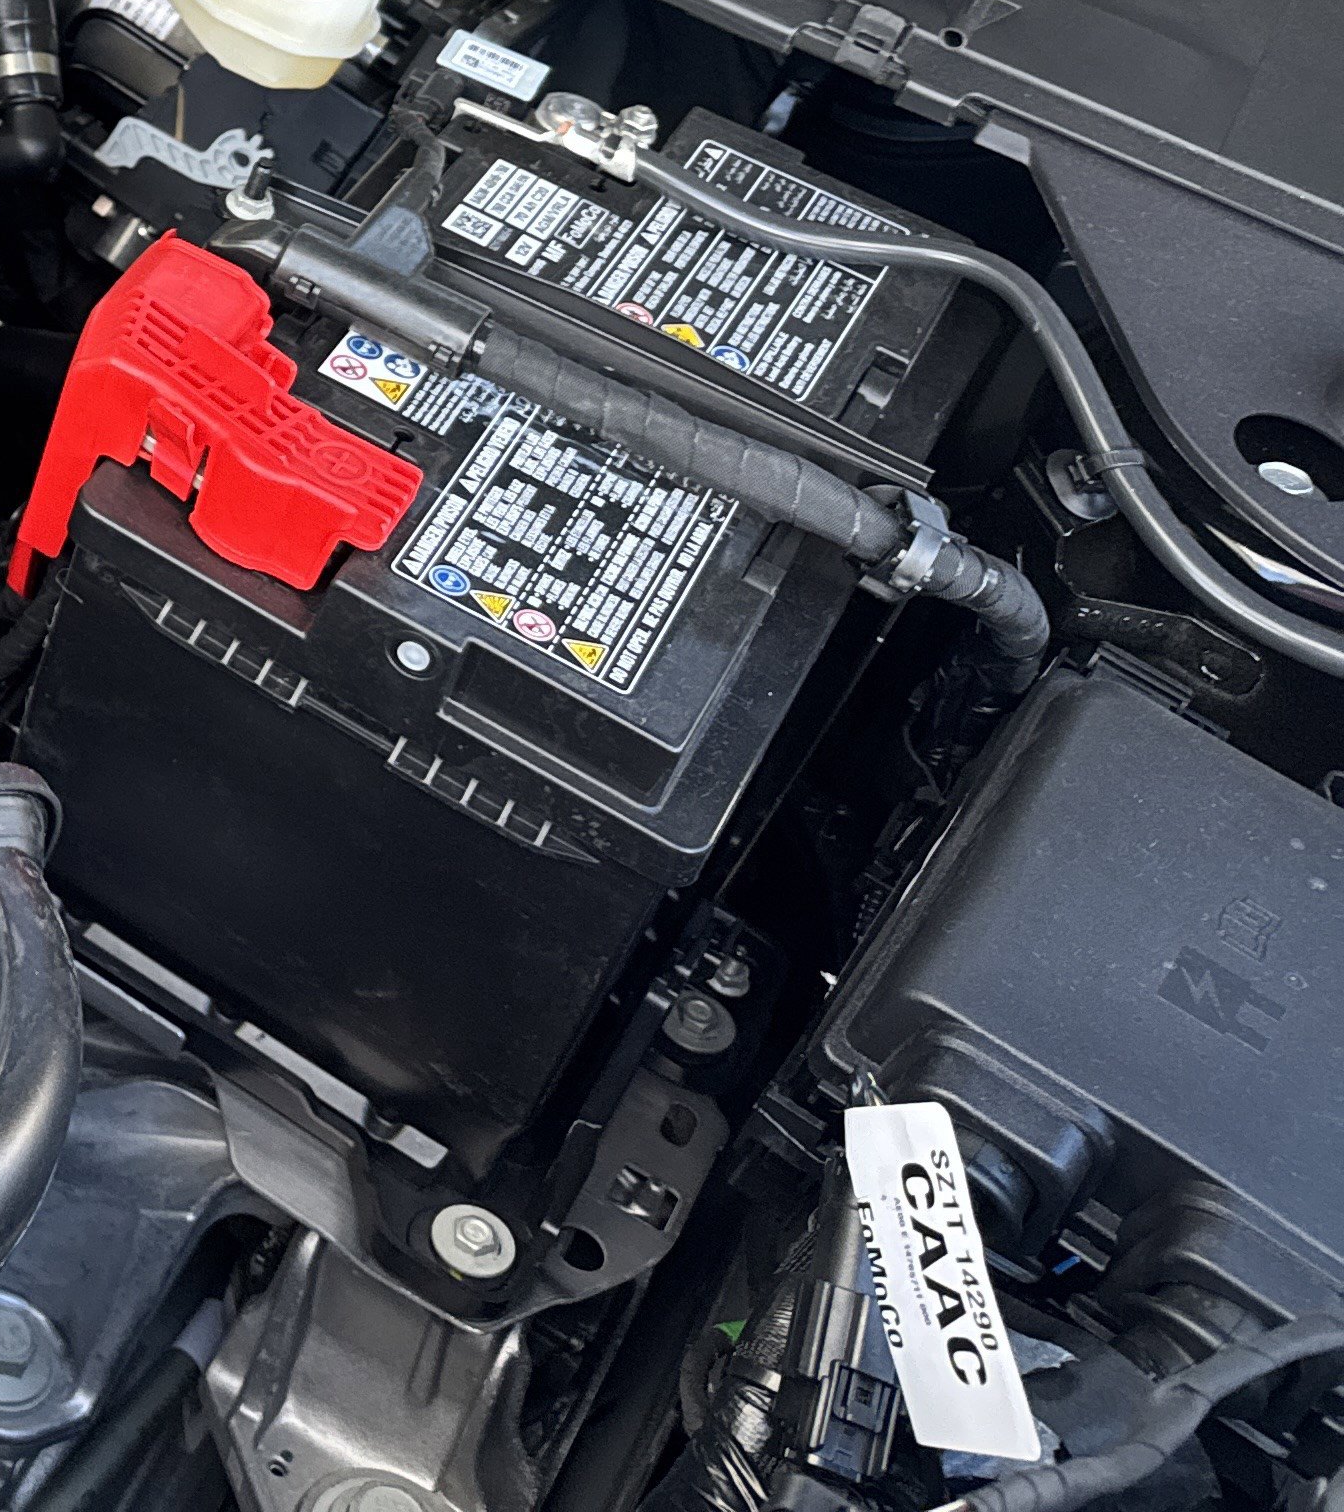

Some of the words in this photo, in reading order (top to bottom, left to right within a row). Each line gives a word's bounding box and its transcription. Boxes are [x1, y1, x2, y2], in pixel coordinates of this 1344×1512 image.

[560, 202, 603, 244] FoMoCo
[857, 1201, 904, 1349] FoMoCo
[901, 1162, 987, 1386] CAAC
[930, 1150, 967, 1235] SZ1T
[955, 1250, 999, 1351] 14290
